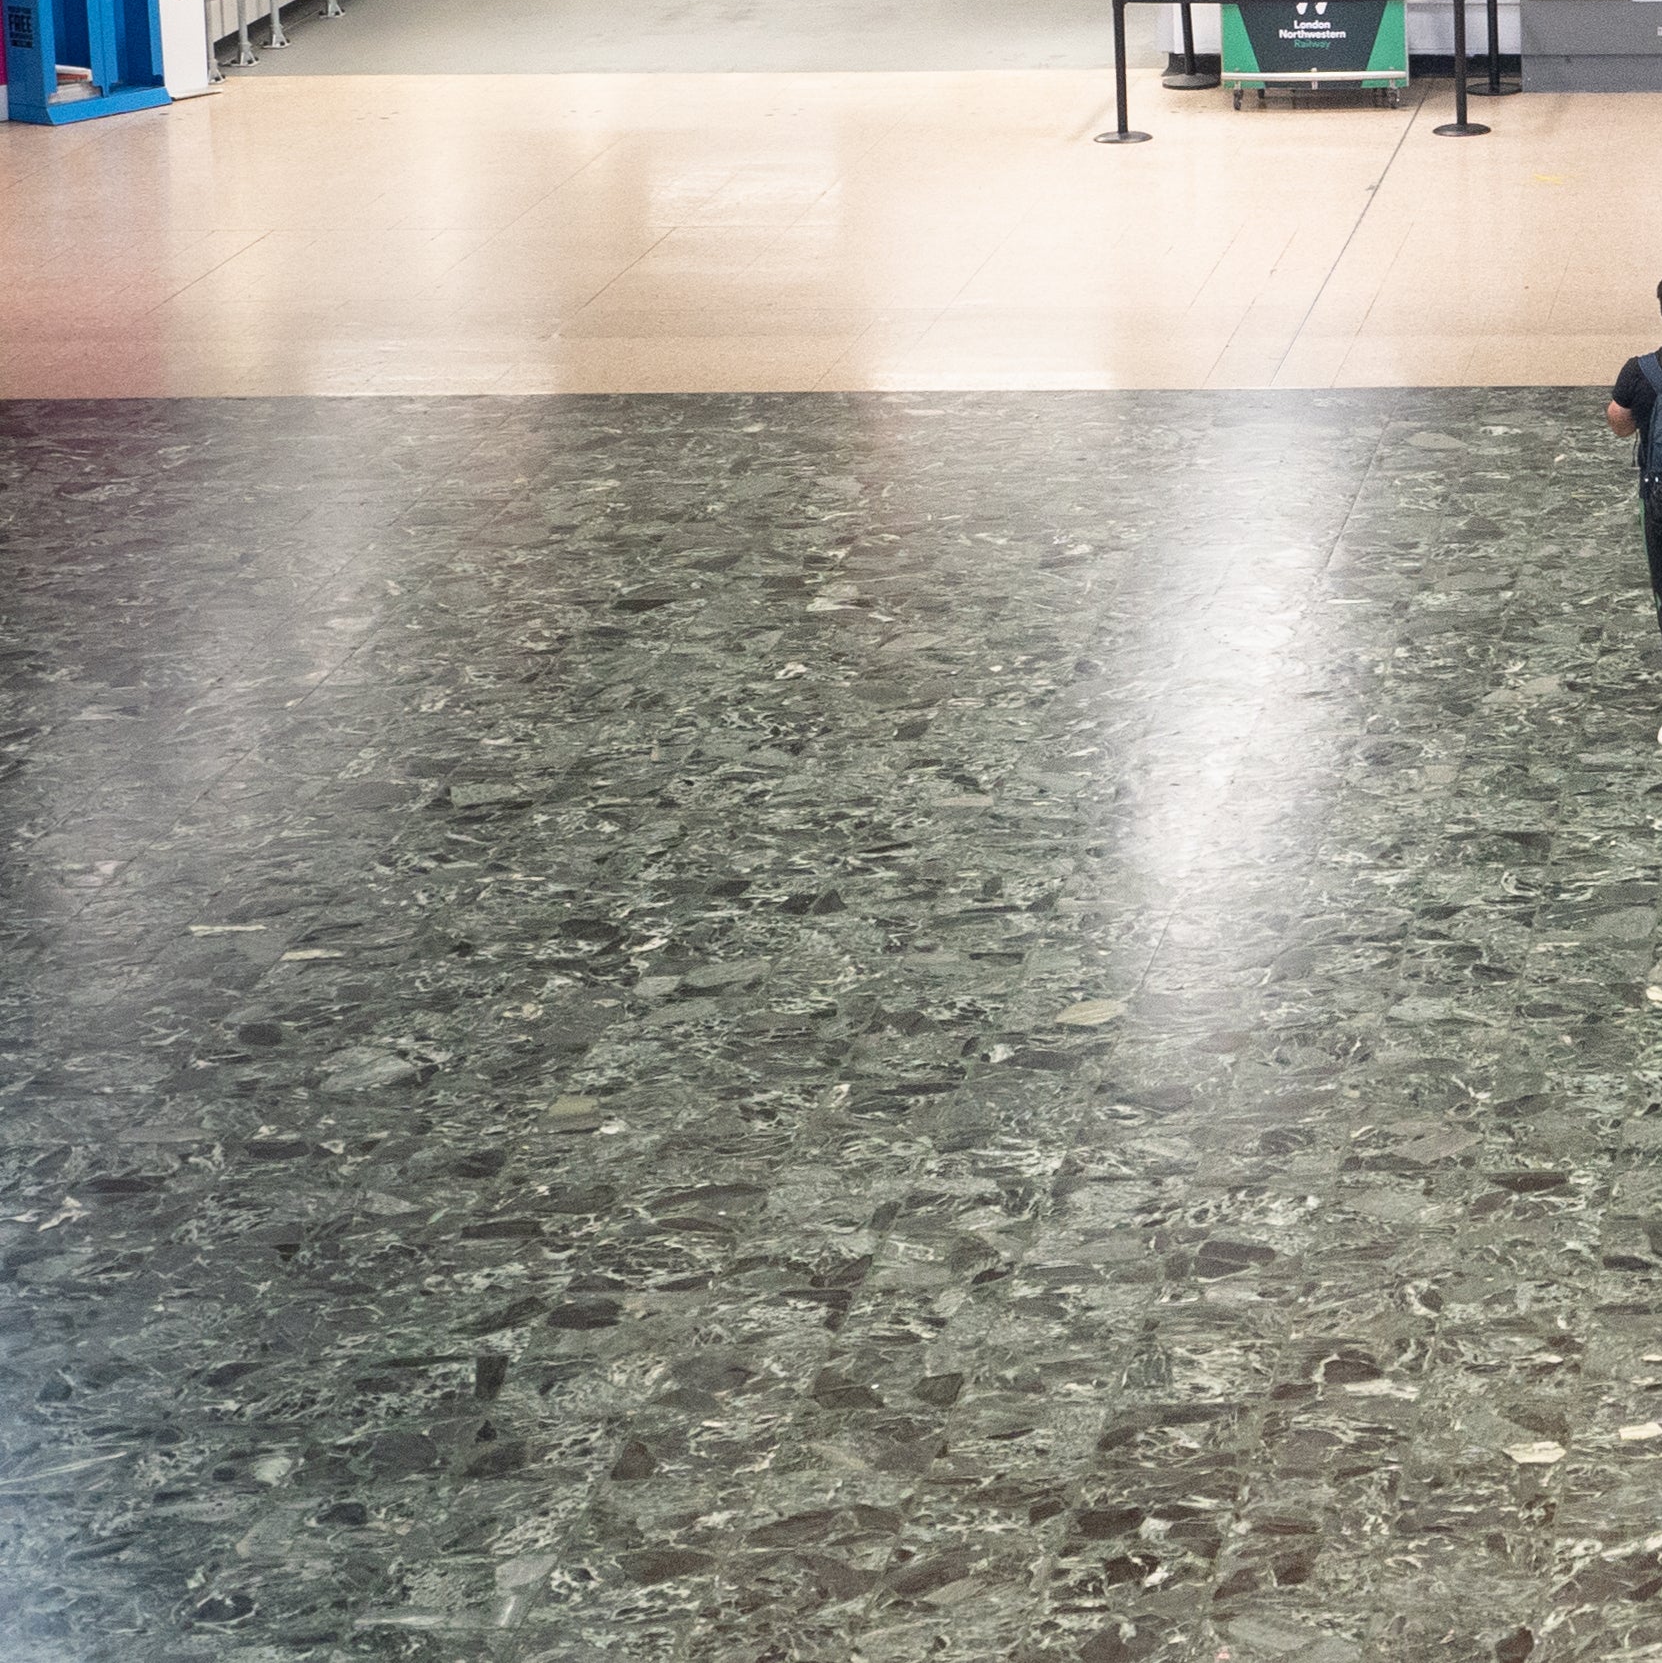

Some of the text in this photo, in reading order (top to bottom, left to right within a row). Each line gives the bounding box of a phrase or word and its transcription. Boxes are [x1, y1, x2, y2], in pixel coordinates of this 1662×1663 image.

[1293, 19, 1332, 30] London
[1278, 29, 1347, 39] Northwestern
[1294, 39, 1332, 50] Railway
